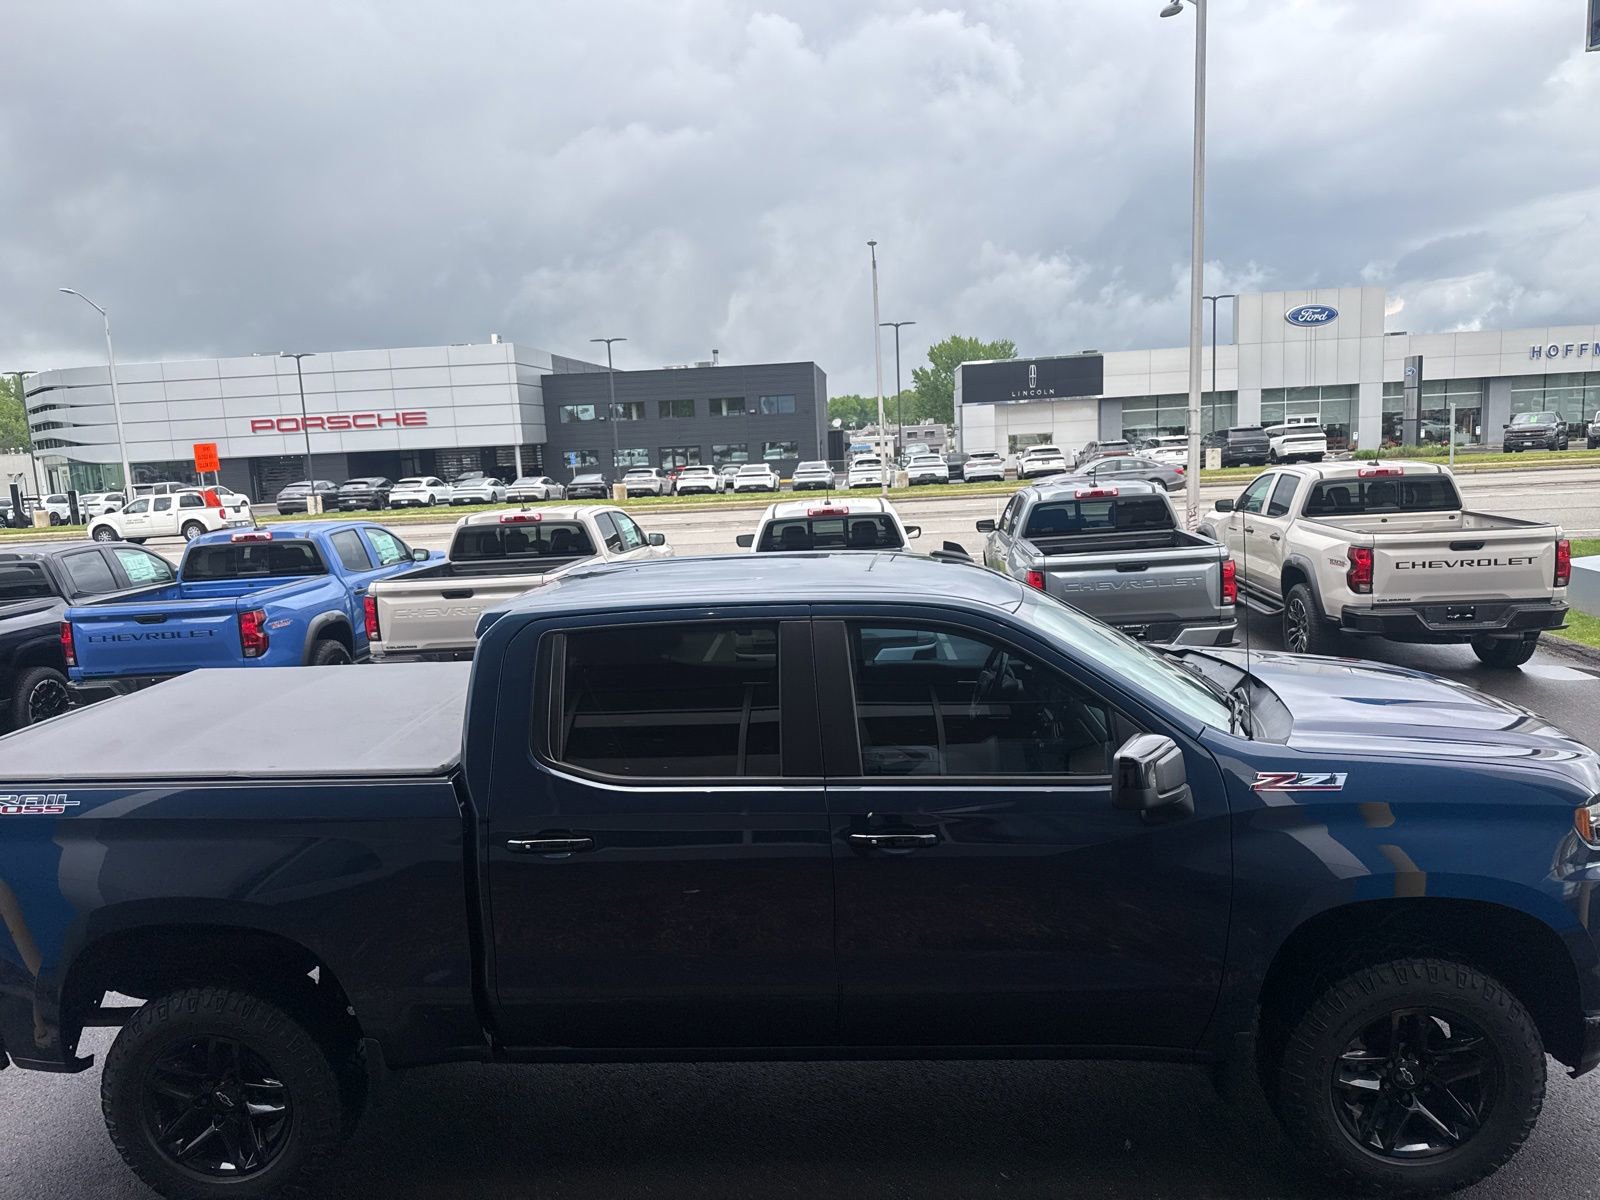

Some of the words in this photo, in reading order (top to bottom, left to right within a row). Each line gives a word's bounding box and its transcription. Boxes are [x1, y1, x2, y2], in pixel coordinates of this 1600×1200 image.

[1298, 308, 1329, 321] Ford
[1011, 389, 1055, 397] LINCOLN
[250, 411, 428, 433] PORSCHE
[1395, 556, 1538, 570] CHEVROLET
[1064, 576, 1203, 593] CHEVROLET
[393, 605, 487, 619] CHEVRO
[87, 629, 218, 643] CHEVROLET
[1249, 771, 1348, 792] Z71
